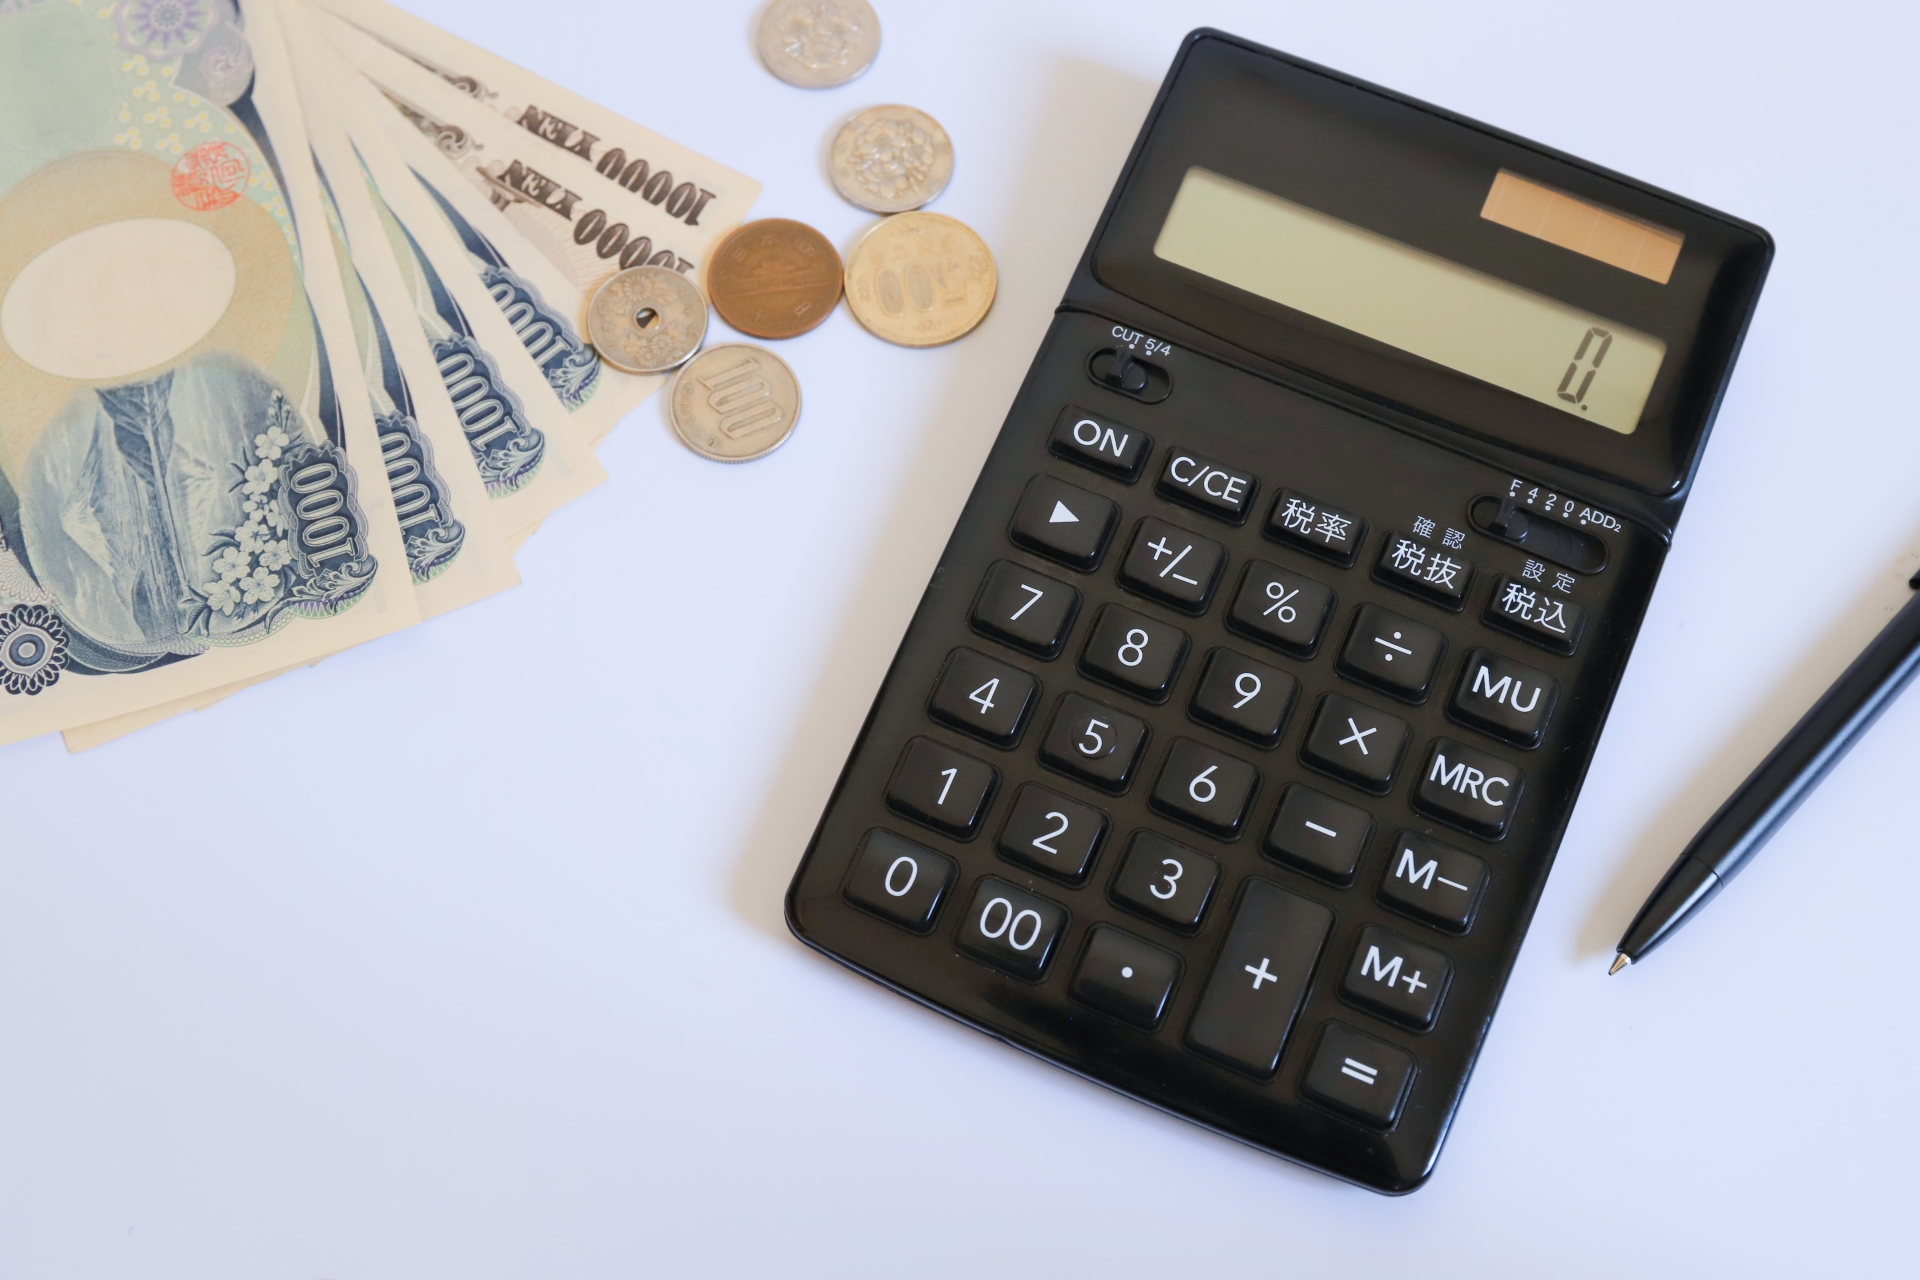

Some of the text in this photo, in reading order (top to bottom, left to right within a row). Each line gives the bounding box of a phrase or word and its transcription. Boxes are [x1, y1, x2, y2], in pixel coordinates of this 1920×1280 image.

[517, 104, 716, 226] 10000 YEN
[497, 159, 583, 221] YEN
[1112, 326, 1171, 356] CUT 5/4
[436, 353, 518, 451] 1000
[696, 358, 782, 439] 100
[1073, 419, 1129, 457] ON
[379, 432, 440, 535] 1000
[1170, 456, 1246, 504] C/CE
[1510, 479, 1522, 490] F
[1528, 487, 1538, 498] 4
[1545, 494, 1557, 507] 2
[1564, 500, 1574, 513] 0
[291, 463, 355, 567] 1000
[1281, 498, 1352, 543] 税率
[1391, 538, 1462, 590] 税抜
[1010, 583, 1044, 621] 7
[1262, 581, 1300, 623] %
[1502, 582, 1567, 634] 税込
[1117, 628, 1149, 667] 8
[968, 677, 1000, 714] 4
[1232, 672, 1262, 709] 9
[1472, 665, 1542, 713] MU
[1078, 718, 1109, 755] 5
[937, 768, 958, 805] 1
[1189, 765, 1219, 803] 6
[1429, 754, 1510, 807] MRC
[1032, 811, 1069, 854] 2
[884, 856, 918, 897] 0
[1149, 858, 1183, 900] 3
[980, 897, 1042, 951] 00
[1245, 957, 1278, 990] +
[1361, 945, 1428, 994] M+
[1341, 1057, 1378, 1085] =
